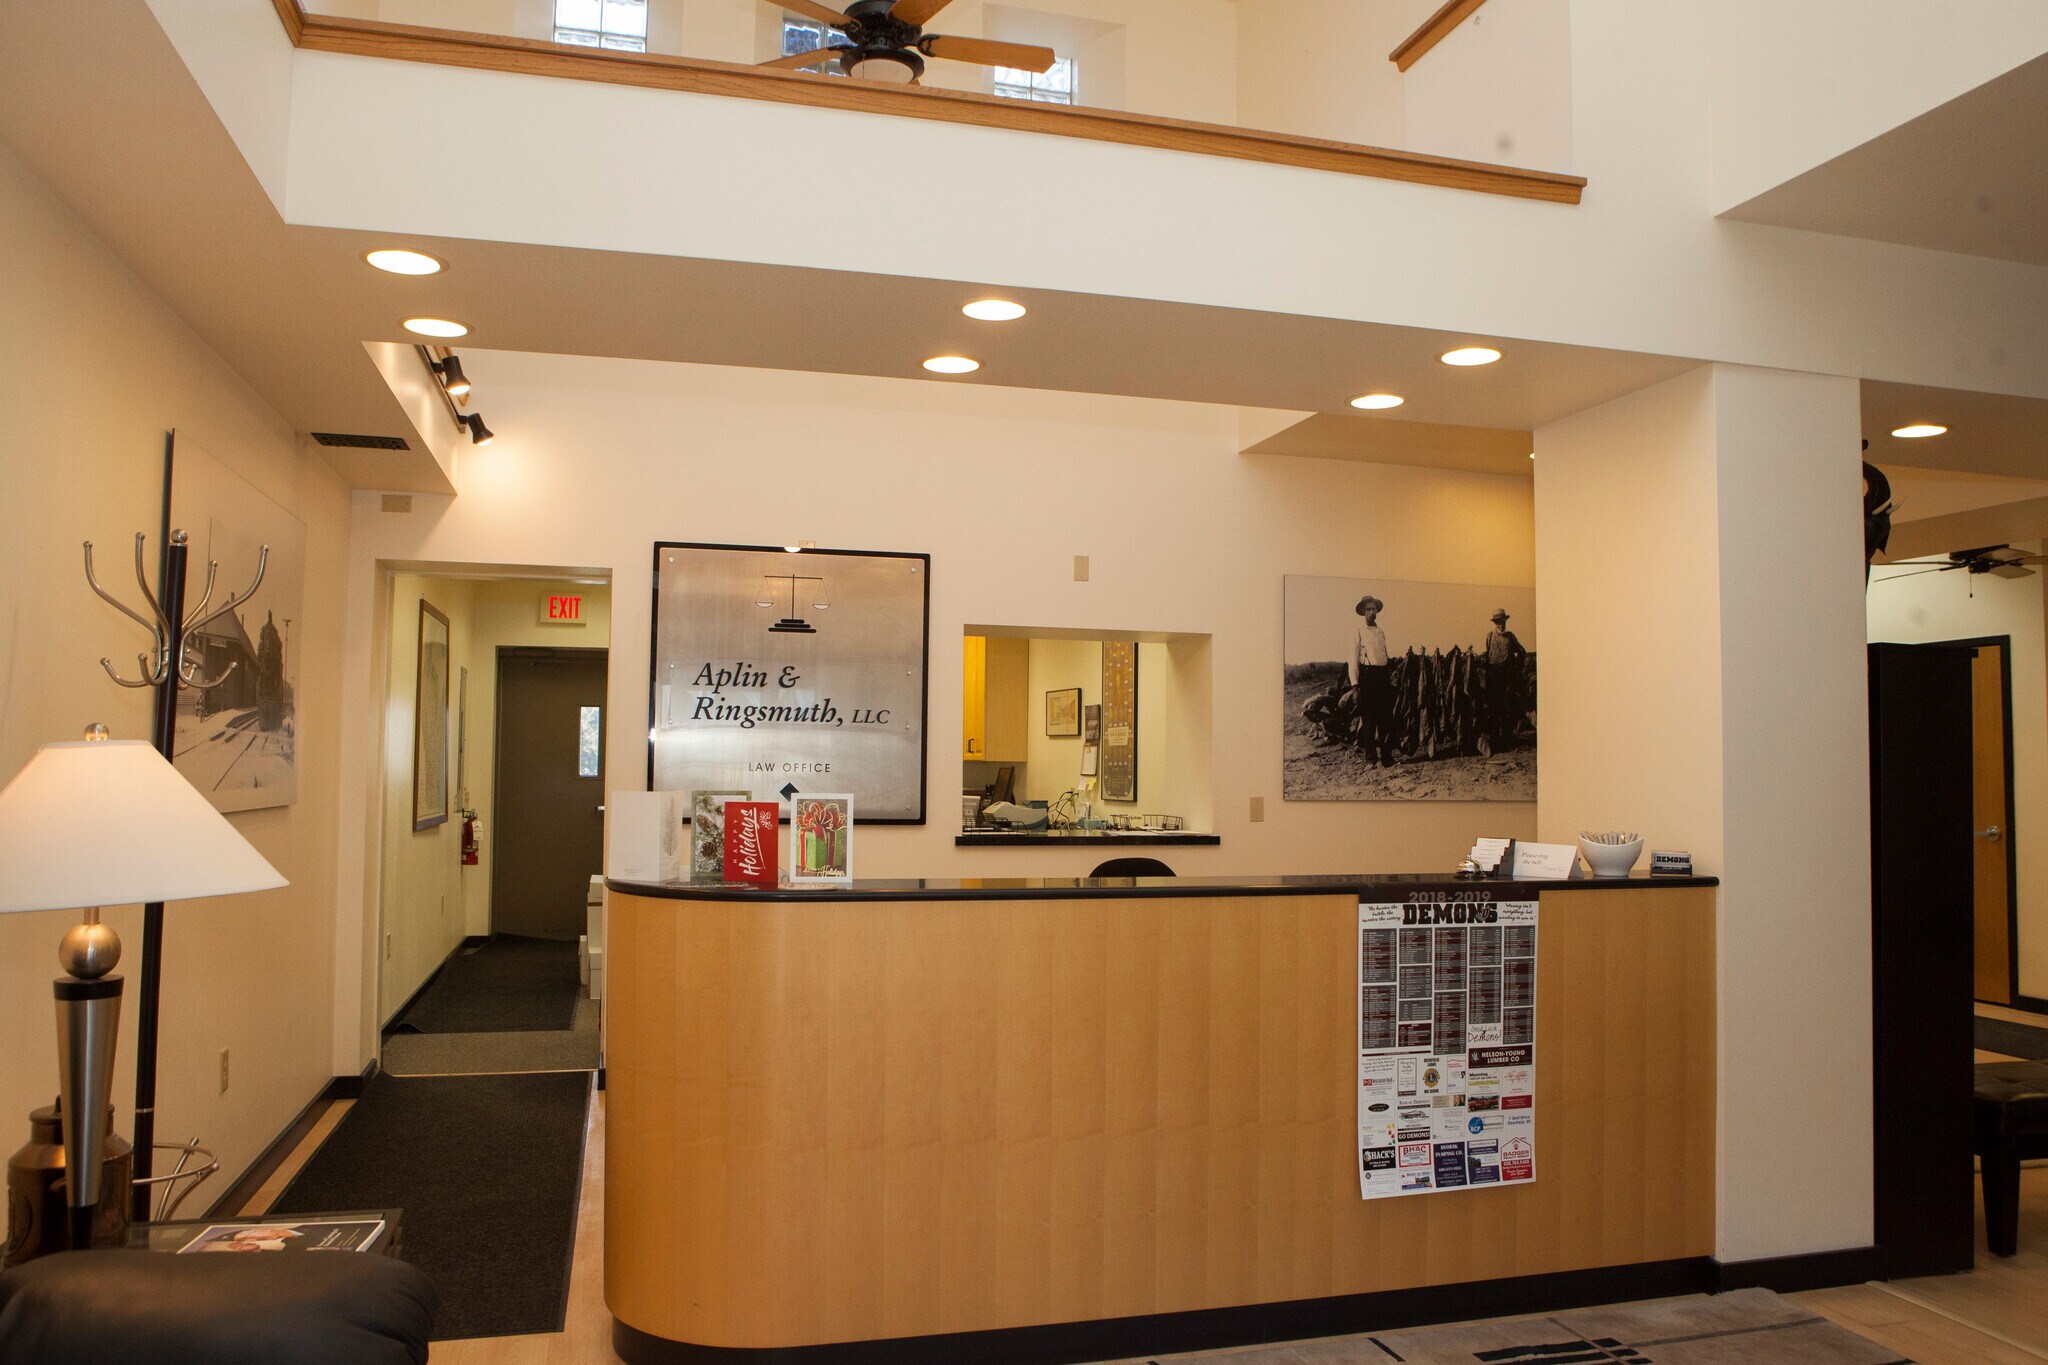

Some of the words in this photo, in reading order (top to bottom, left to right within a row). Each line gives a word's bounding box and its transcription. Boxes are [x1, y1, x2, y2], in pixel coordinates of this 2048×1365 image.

[549, 596, 581, 619] EXIT
[692, 662, 768, 694] Aplin
[778, 666, 800, 688] &
[691, 697, 843, 729] Ringsmuth,
[851, 709, 890, 724] LLC
[748, 762, 776, 772] LAW
[782, 763, 831, 773] OFFICE
[739, 808, 763, 876] Holidays
[1409, 891, 1492, 903] 2018-2019
[1403, 903, 1498, 925] DEMONS
[1481, 1050, 1526, 1058] NELSON-YOUNG
